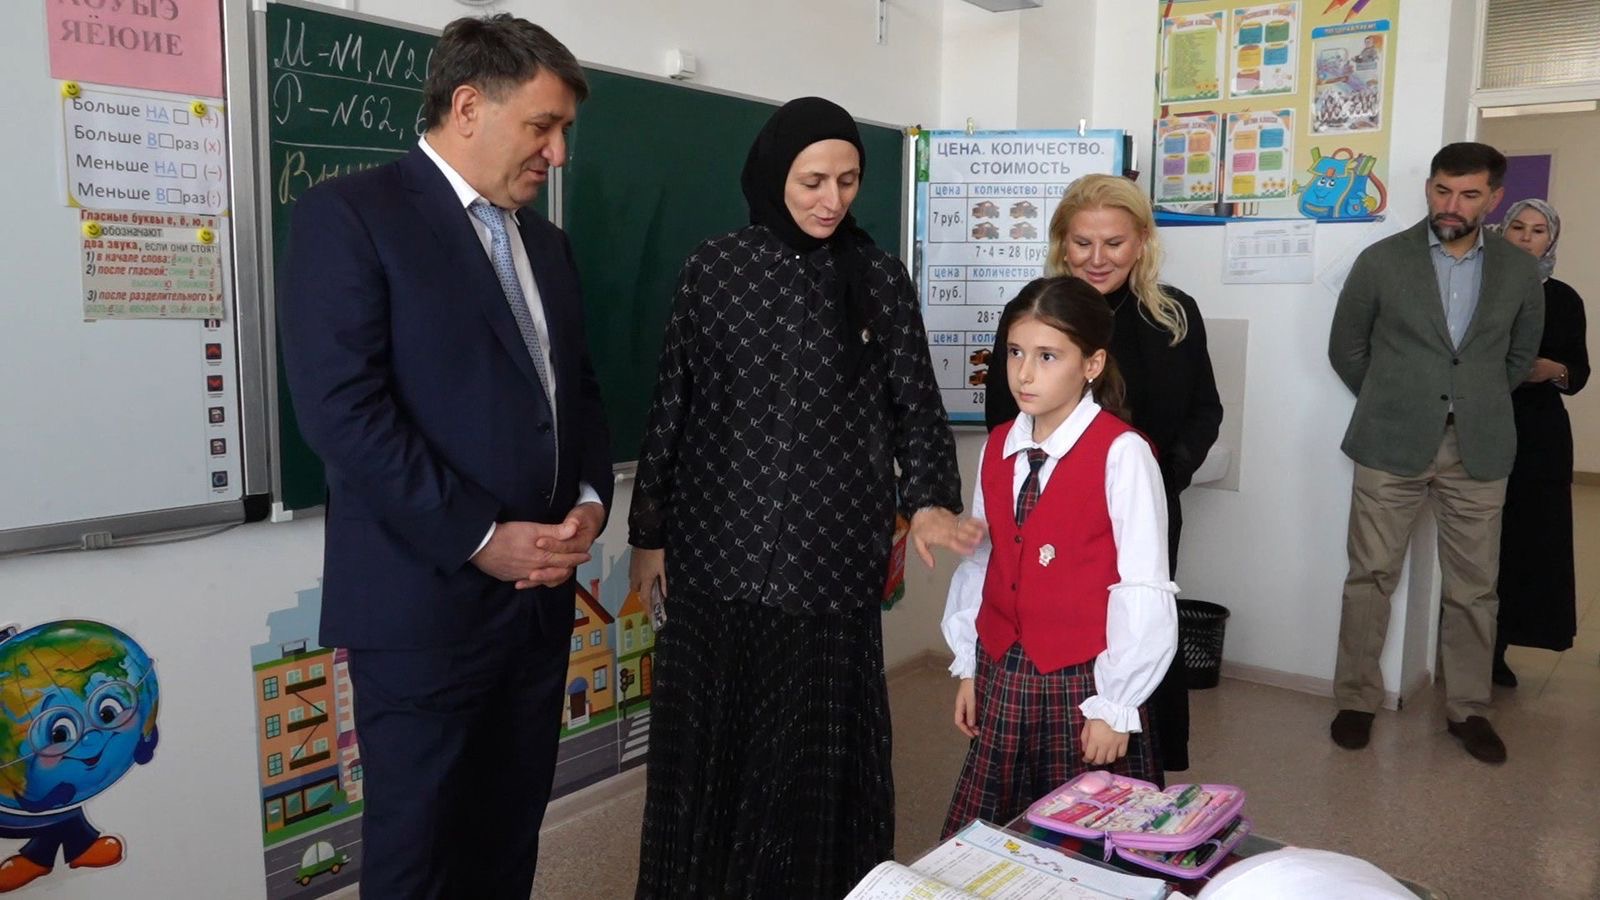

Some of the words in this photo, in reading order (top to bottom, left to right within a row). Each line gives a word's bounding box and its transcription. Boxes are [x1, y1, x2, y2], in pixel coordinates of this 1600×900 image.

[60, 14, 184, 57] ЯЁЮИЕ
[73, 97, 140, 117] Больше
[146, 104, 169, 121] НА
[74, 125, 142, 145] Больше
[147, 132, 158, 148] В
[176, 139, 199, 151] раз
[937, 142, 985, 157] ЦЕНА.
[991, 142, 1105, 156] КОЛИЧЕСТВО.
[76, 153, 149, 173] Меньше
[155, 161, 178, 176] НА
[970, 161, 1071, 175] СТОИМОСТЬ
[78, 182, 151, 201] Меньше
[156, 188, 166, 203] В
[935, 186, 961, 196] цена
[974, 185, 1038, 195] количество
[81, 210, 129, 223] Гласные
[132, 213, 165, 225] буквы
[933, 211, 939, 223] 7
[941, 211, 963, 227] руб.
[102, 226, 163, 238] обозначают
[84, 239, 104, 250] два
[107, 241, 142, 252] звука,
[145, 242, 168, 251] если
[171, 244, 188, 253] они
[975, 246, 980, 257] 7
[989, 246, 994, 257] 4
[1009, 245, 1021, 257] 28
[86, 252, 95, 263] 1)
[106, 254, 139, 264] начале
[141, 254, 170, 265] слова:
[86, 265, 96, 277] 2)
[98, 266, 128, 276] после
[129, 264, 168, 277] гласной:
[934, 268, 960, 279] цена
[973, 267, 1037, 278] количество
[87, 290, 97, 302] 3)
[99, 291, 126, 301] после
[129, 292, 207, 303] разделительного
[932, 286, 938, 298] 7
[939, 286, 962, 301] руб.
[998, 286, 1004, 298] ?
[933, 332, 958, 343] цена
[943, 358, 949, 371] ?
[973, 391, 985, 404] 28
